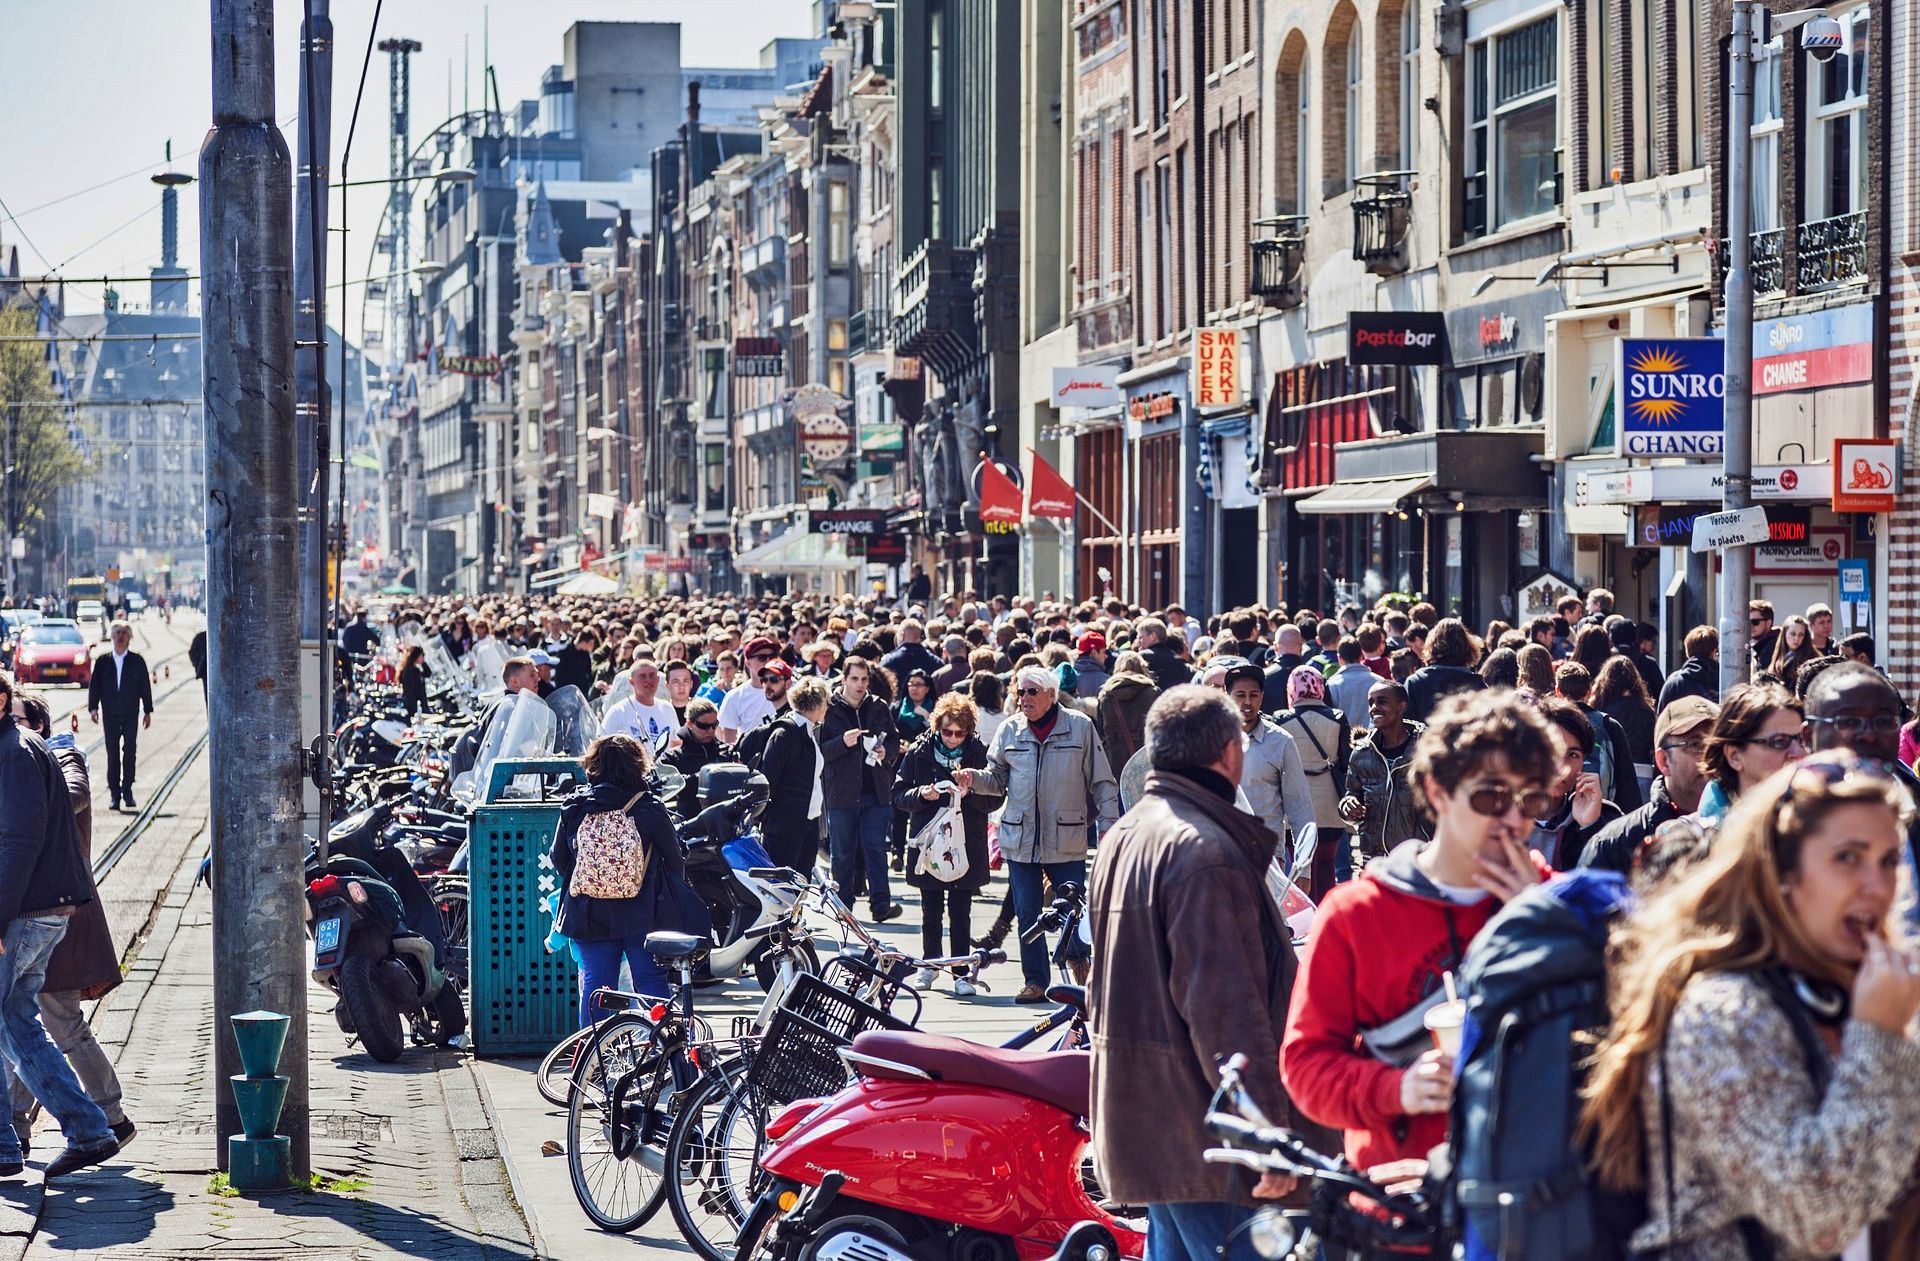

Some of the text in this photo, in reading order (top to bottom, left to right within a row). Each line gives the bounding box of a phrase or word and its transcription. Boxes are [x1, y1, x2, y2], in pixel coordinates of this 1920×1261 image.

[1769, 325, 1803, 347] SUNRO
[737, 359, 781, 376] HOTEL
[1200, 332, 1214, 403] SUPER
[1219, 332, 1235, 403] MARKT
[1763, 359, 1807, 388] CHANGE
[1630, 373, 1724, 398] SUNRO
[819, 520, 874, 533] CHANGE
[1759, 546, 1821, 558] MoneyGram
[320, 921, 338, 932] 62F
